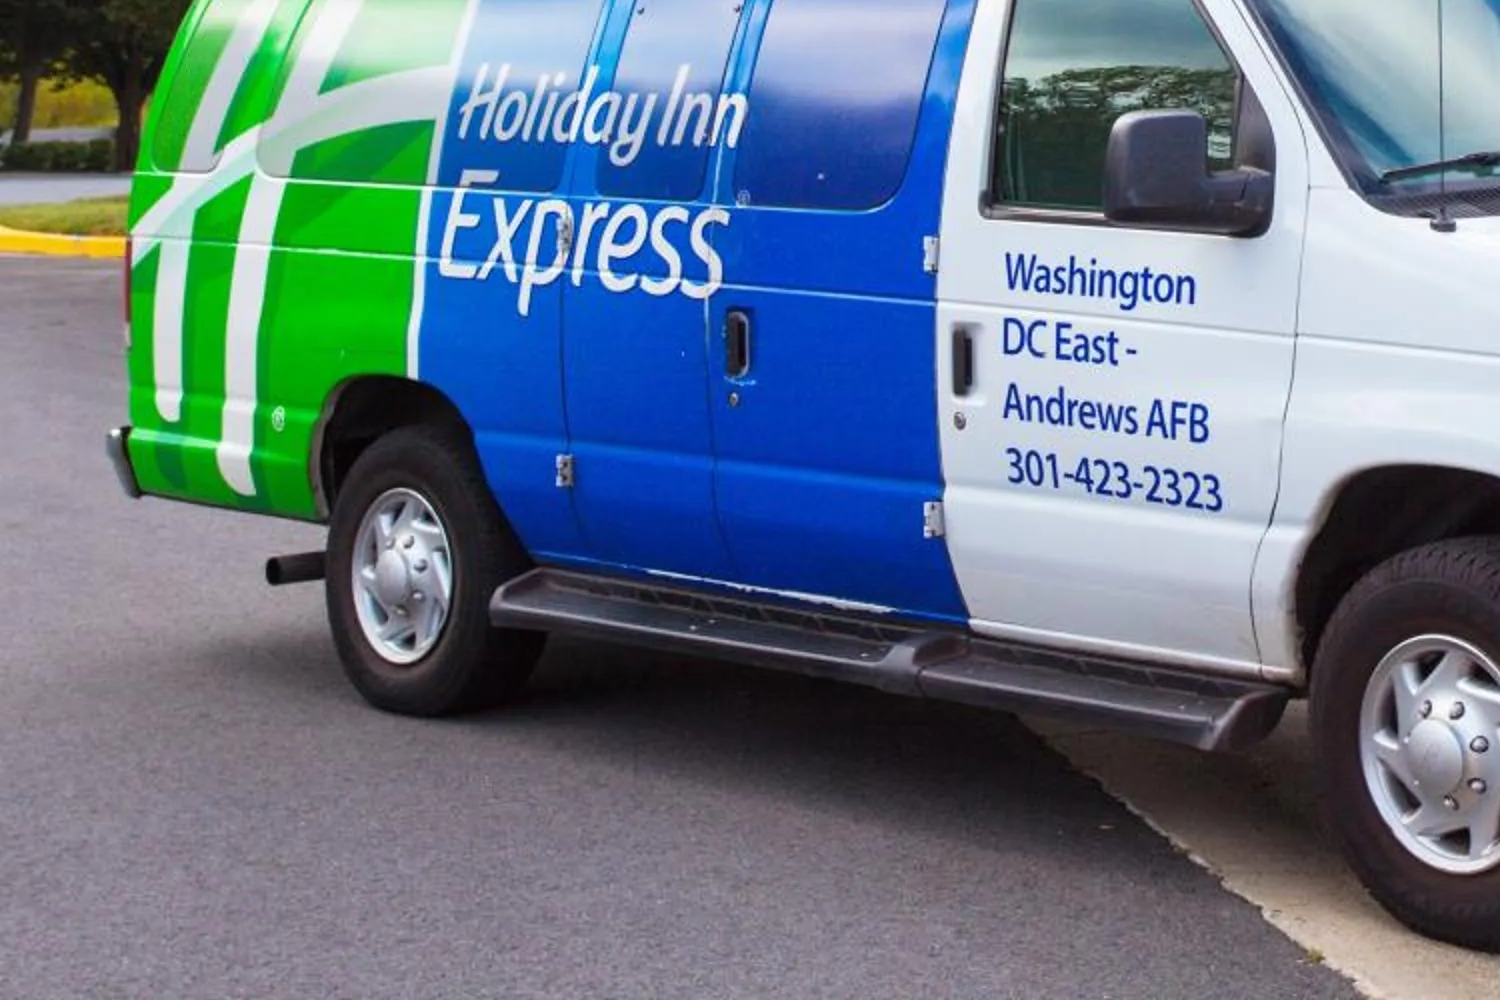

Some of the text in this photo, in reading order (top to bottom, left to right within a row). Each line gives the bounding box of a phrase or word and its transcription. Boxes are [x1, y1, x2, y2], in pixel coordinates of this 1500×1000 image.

[458, 62, 749, 167] Holiday Inn
[439, 169, 731, 317] Express
[1004, 251, 1197, 311] Washington
[1002, 316, 1048, 359] DC
[1002, 382, 1211, 444] Andrews AFB
[1005, 446, 1224, 513] 301-423-2323
